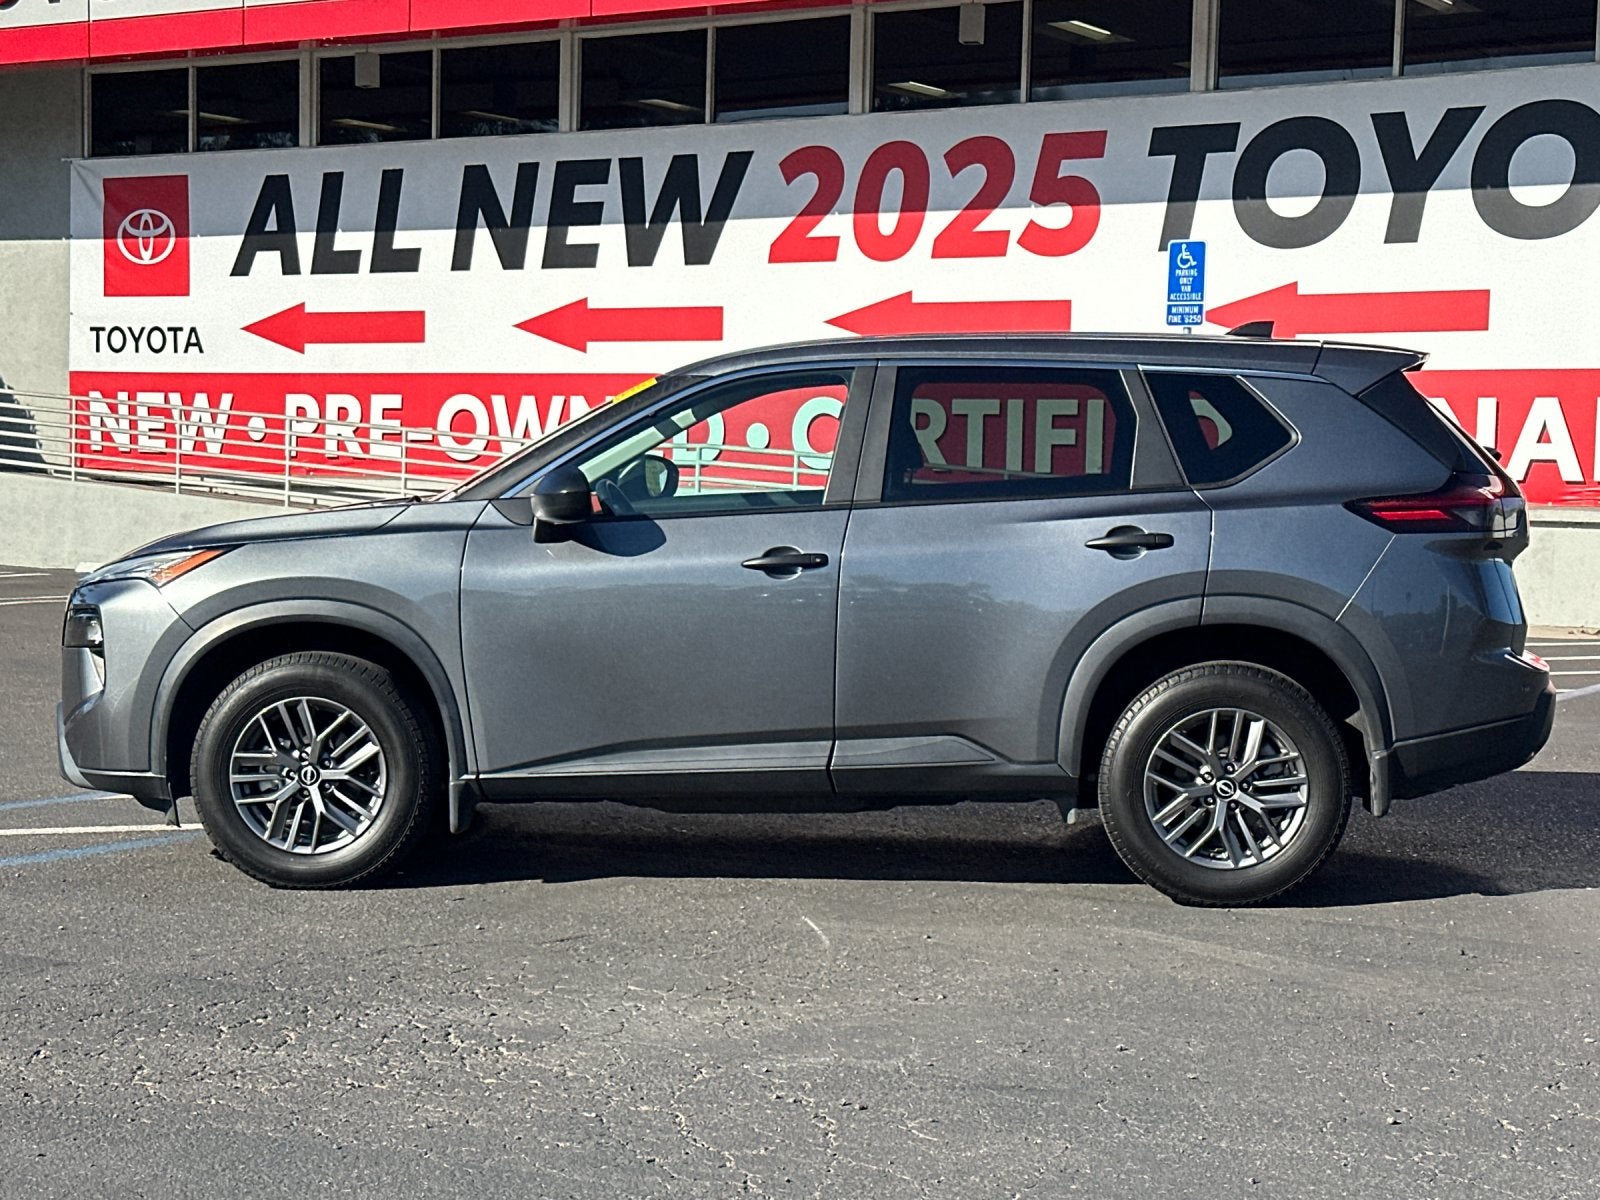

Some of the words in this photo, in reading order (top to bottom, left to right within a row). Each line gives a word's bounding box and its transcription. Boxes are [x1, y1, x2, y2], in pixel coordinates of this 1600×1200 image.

[229, 168, 421, 277] ALL
[451, 150, 754, 272] NEW
[768, 130, 1107, 263] 2025
[1147, 98, 1600, 252] TOYO
[1175, 268, 1198, 277] PARKING
[1179, 277, 1193, 285] ONLY
[1169, 292, 1202, 300] ACCESSIBLE
[1171, 306, 1199, 314] MINIMUM
[1168, 314, 1182, 323] FINE
[1183, 314, 1202, 324] $250
[89, 325, 205, 354] TOYOTA
[88, 390, 234, 455] NEW
